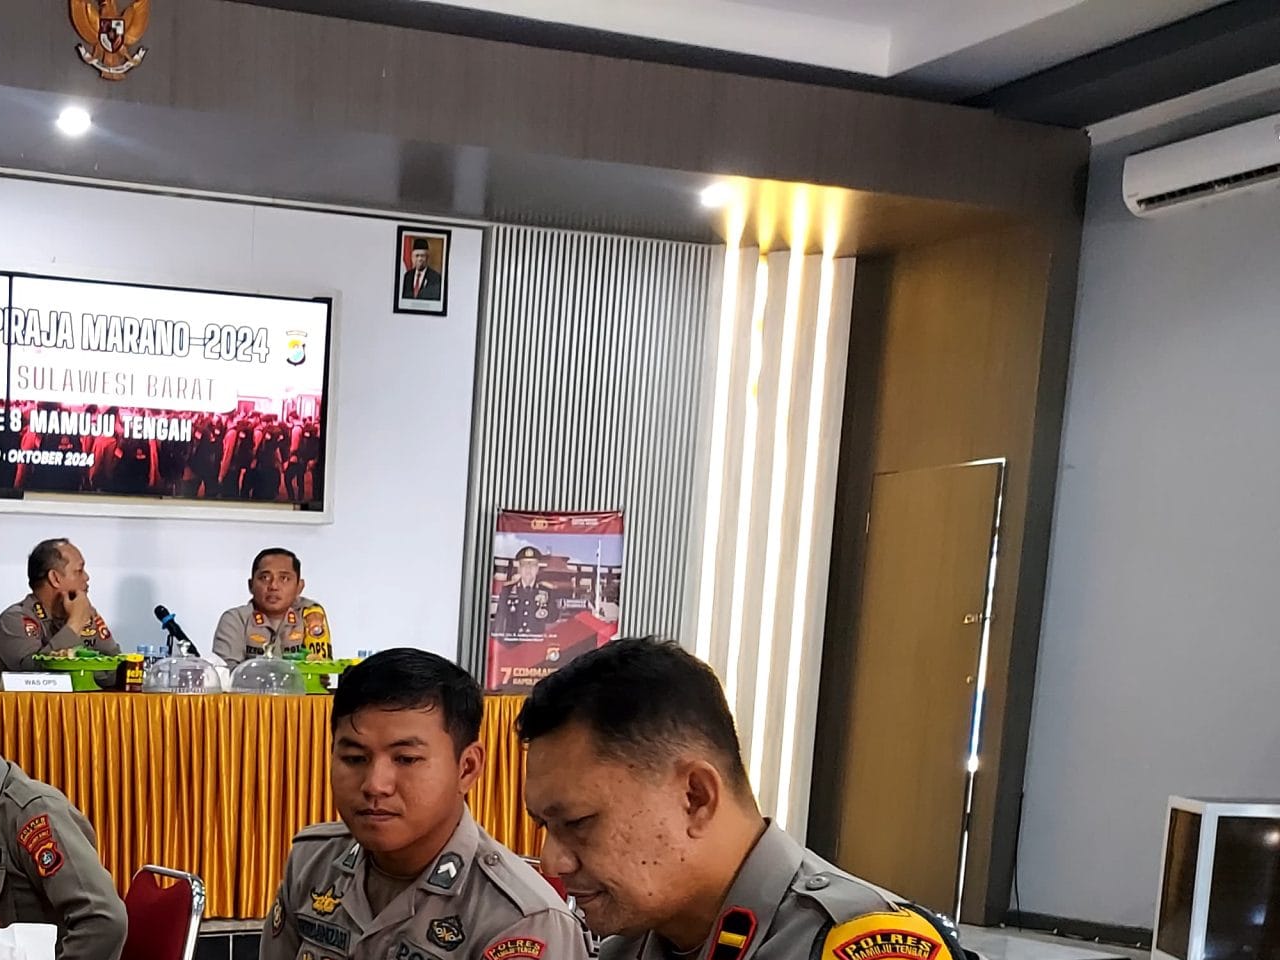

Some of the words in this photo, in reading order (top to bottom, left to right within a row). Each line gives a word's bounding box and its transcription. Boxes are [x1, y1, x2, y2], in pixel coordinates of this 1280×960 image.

[17, 365, 134, 397] SULAWESI
[147, 374, 216, 401] BARAT
[29, 409, 115, 438] MAMUJU
[123, 415, 192, 442] TENGAH
[7, 449, 63, 467] OKTOBER
[64, 450, 95, 467] 2024
[500, 667, 512, 685] 7
[844, 933, 933, 956] POLRES
